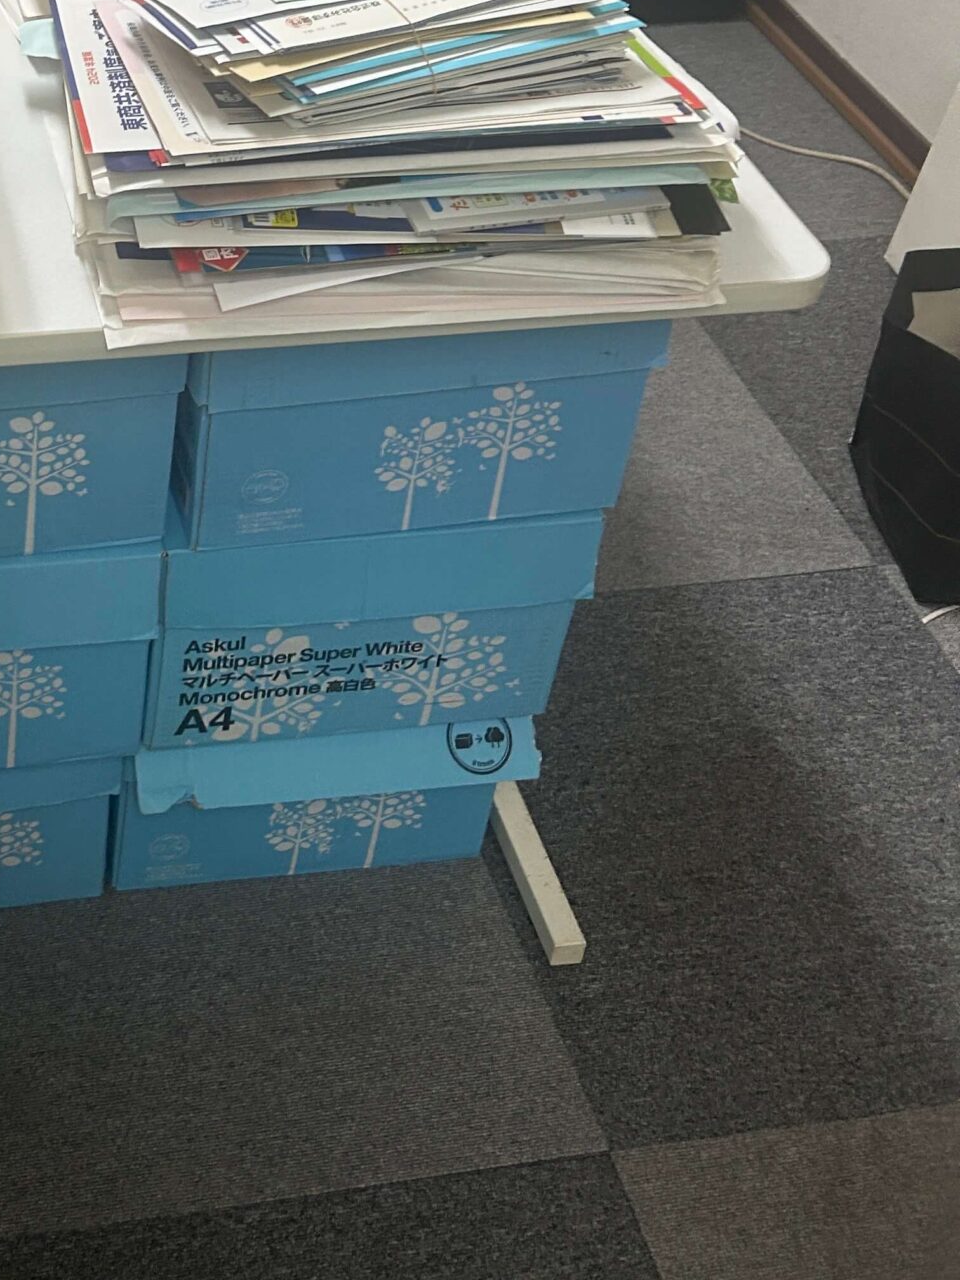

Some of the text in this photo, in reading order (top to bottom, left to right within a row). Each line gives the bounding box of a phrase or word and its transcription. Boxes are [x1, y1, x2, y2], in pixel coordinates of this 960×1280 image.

[183, 639, 424, 673] Multipaper Super White
[184, 636, 246, 655] Askul
[178, 677, 377, 707] Monochrome 高白色
[173, 706, 236, 736] A4
